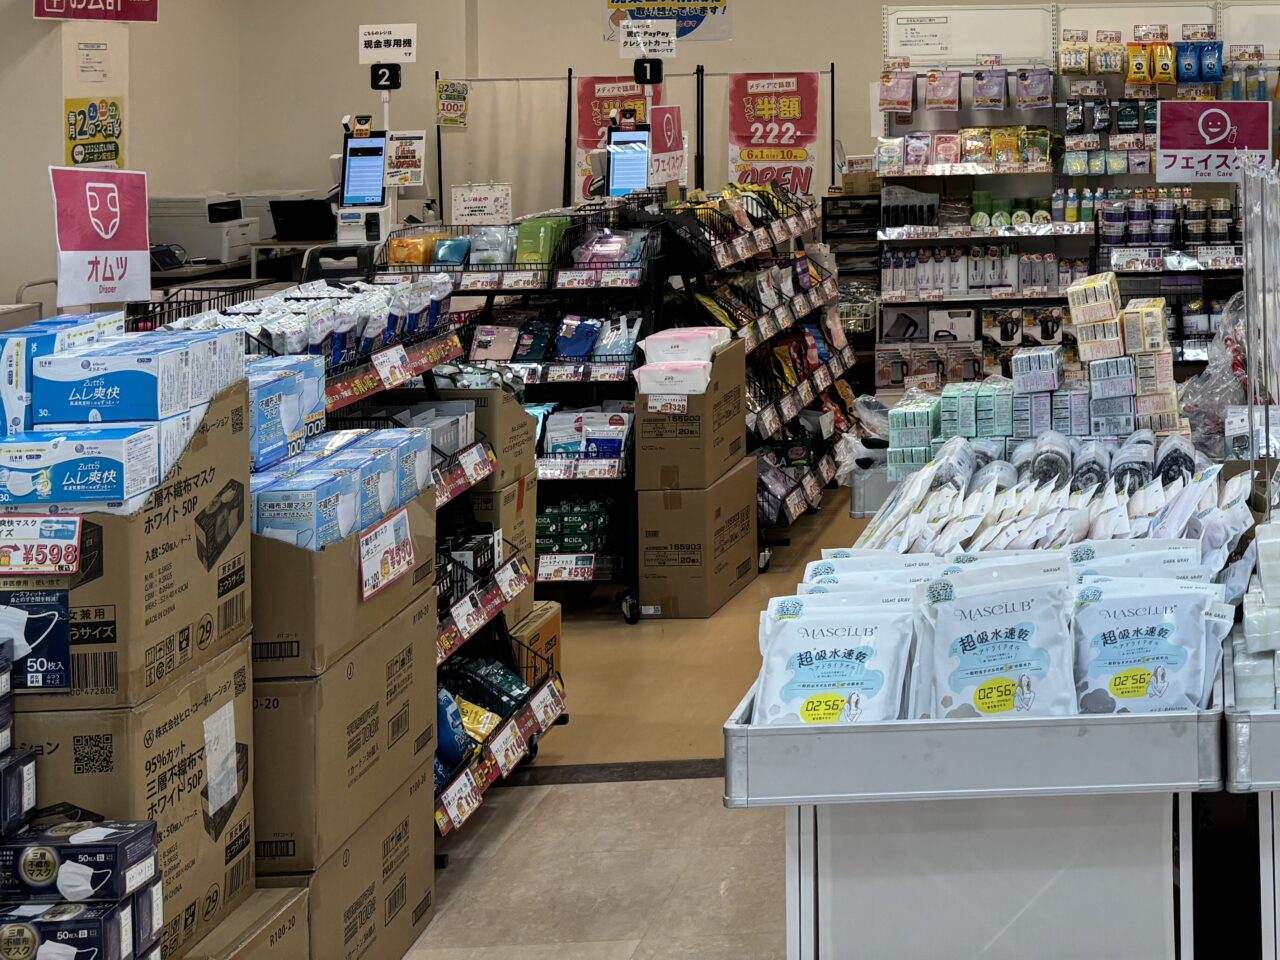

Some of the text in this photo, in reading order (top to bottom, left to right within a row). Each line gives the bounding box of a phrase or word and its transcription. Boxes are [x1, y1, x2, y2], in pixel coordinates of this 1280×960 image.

[635, 6, 727, 17] 取り組んでいます!
[363, 38, 413, 49] 現金専用機
[378, 68, 391, 86] 2
[643, 63, 651, 80] 1
[755, 96, 801, 121] 半額
[750, 122, 796, 144] 222
[737, 166, 813, 194] OPEN
[87, 255, 128, 282] オムツ
[68, 386, 120, 400] ムレ爽快
[264, 406, 279, 419] マスク
[62, 470, 117, 485] ムレ爽快
[144, 495, 198, 534] ホワイト 50P
[262, 502, 313, 510] 不織布3層マスク
[23, 544, 78, 565] ¥598
[953, 600, 1032, 622] MASCLUB
[1099, 605, 1175, 619] MASCLUB
[199, 620, 212, 645] 29
[797, 626, 874, 639] MASCLUB
[27, 657, 64, 672] 50枚入
[144, 739, 186, 777] 95%カット
[187, 768, 203, 794] 50P
[27, 868, 52, 877] マスク
[204, 889, 218, 921] 29
[269, 915, 296, 947] R100-20
[3, 946, 30, 956] マスク
